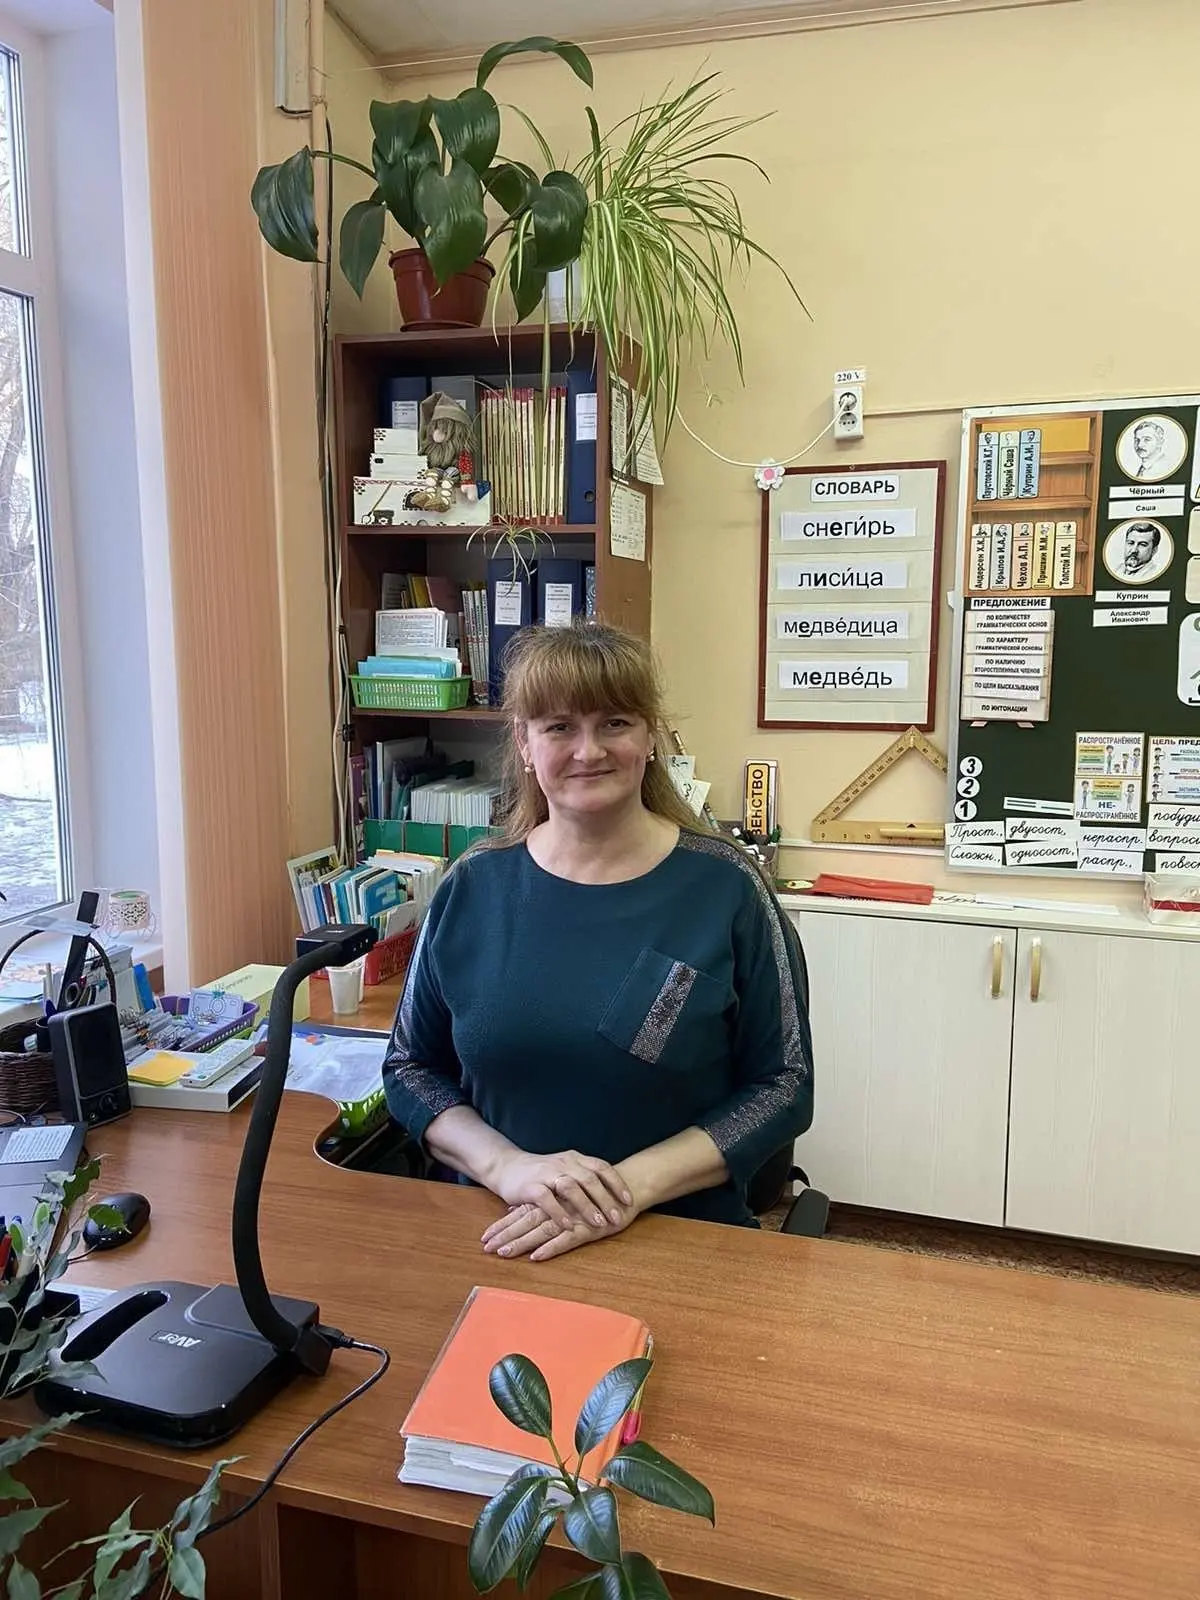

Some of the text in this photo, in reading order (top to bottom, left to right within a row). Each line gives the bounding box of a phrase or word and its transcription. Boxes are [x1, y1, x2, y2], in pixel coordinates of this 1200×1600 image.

[837, 373, 852, 382] 220
[1004, 448, 1015, 468] Саша
[1022, 444, 1034, 493] Куприн А.И.
[814, 480, 896, 496] СЛОВАРЬ
[1129, 486, 1165, 495] Чёрный
[974, 553, 986, 589] Андерсен
[995, 554, 1005, 585] Крылов
[1017, 542, 1029, 588] Чехов А.П.
[1037, 552, 1048, 584] Пришвин
[1060, 559, 1071, 586] Толстой
[973, 599, 1047, 608] ПРЕДЛОЖЕНИЕ
[1116, 592, 1149, 602] Куприн
[1110, 610, 1151, 618] Александр
[966, 758, 976, 774] 3
[962, 778, 974, 795] 2
[960, 801, 969, 817] 1
[1160, 855, 1200, 869] повес
